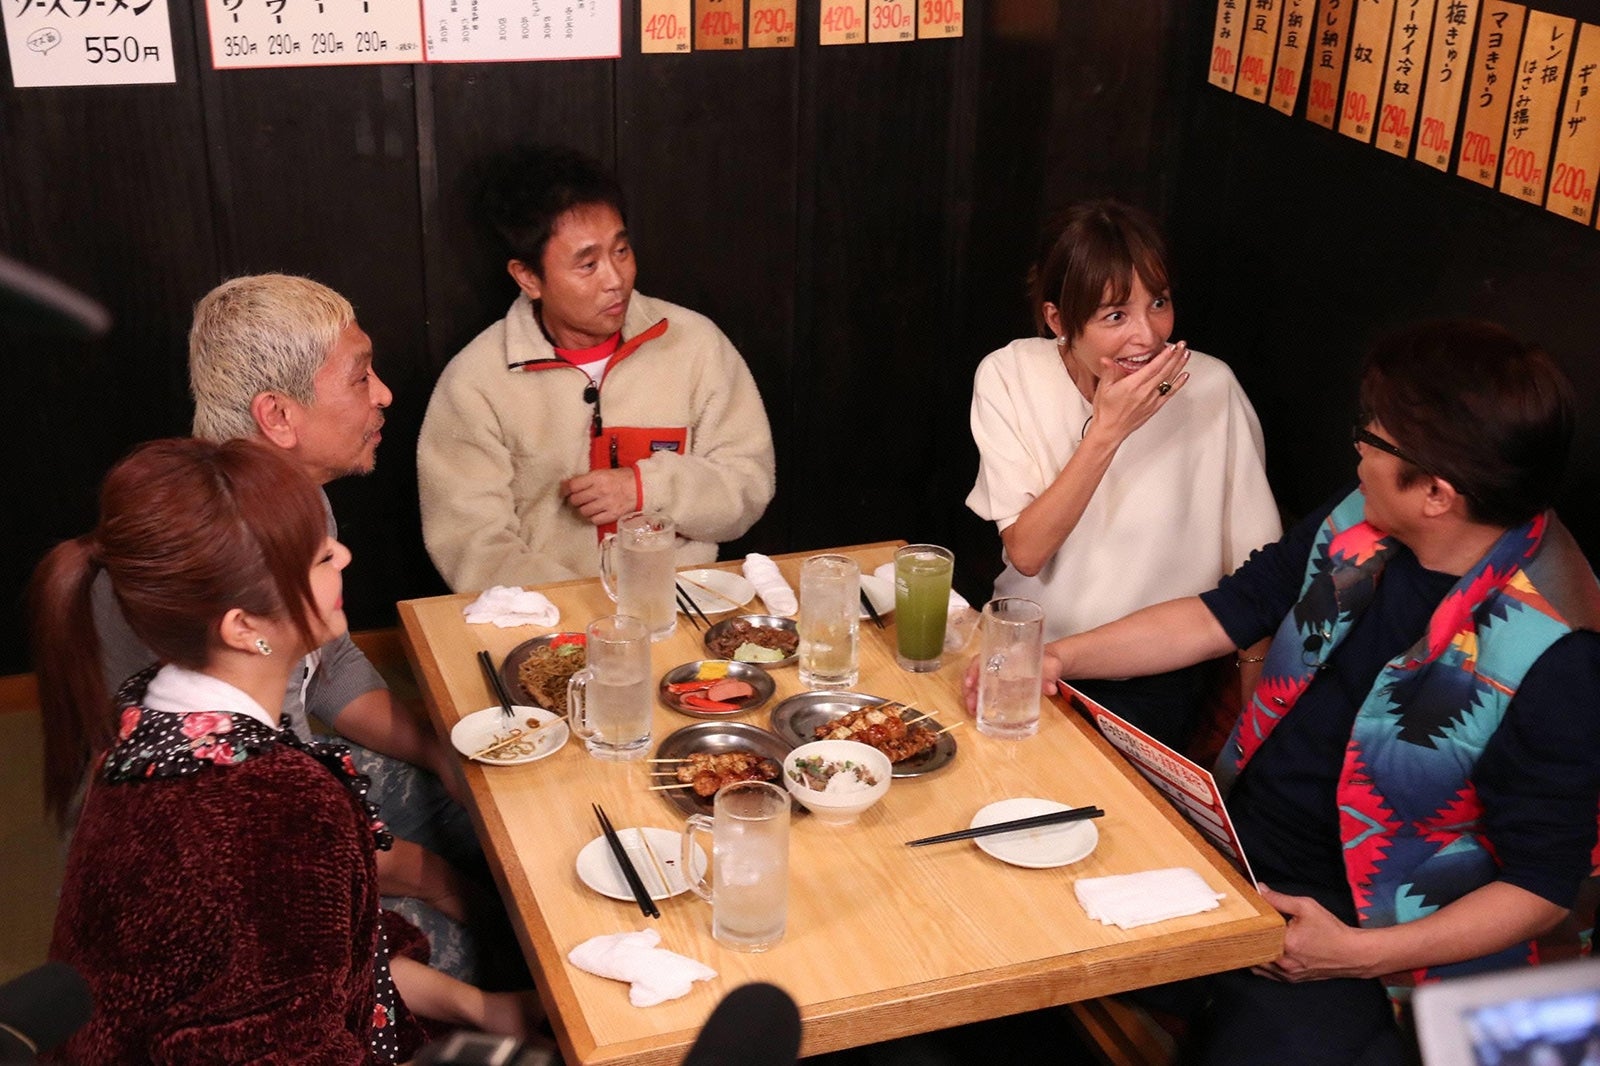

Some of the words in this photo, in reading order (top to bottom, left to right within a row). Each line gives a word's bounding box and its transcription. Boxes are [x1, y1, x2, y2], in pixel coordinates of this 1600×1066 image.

[645, 14, 687, 40] 420円
[754, 8, 794, 34] 290円
[872, 4, 910, 30] 390円
[85, 36, 160, 64] 550円
[224, 35, 257, 56] 350円
[267, 33, 300, 55] 290円
[311, 32, 343, 54] 290円
[355, 31, 387, 52] 290円
[1480, 11, 1509, 108] マヨきゅう
[1343, 90, 1370, 122] 190円
[1567, 63, 1598, 138] ギョーザ
[1462, 131, 1496, 168] 270円
[1504, 146, 1542, 185] 200円
[1552, 162, 1592, 203] 200円
